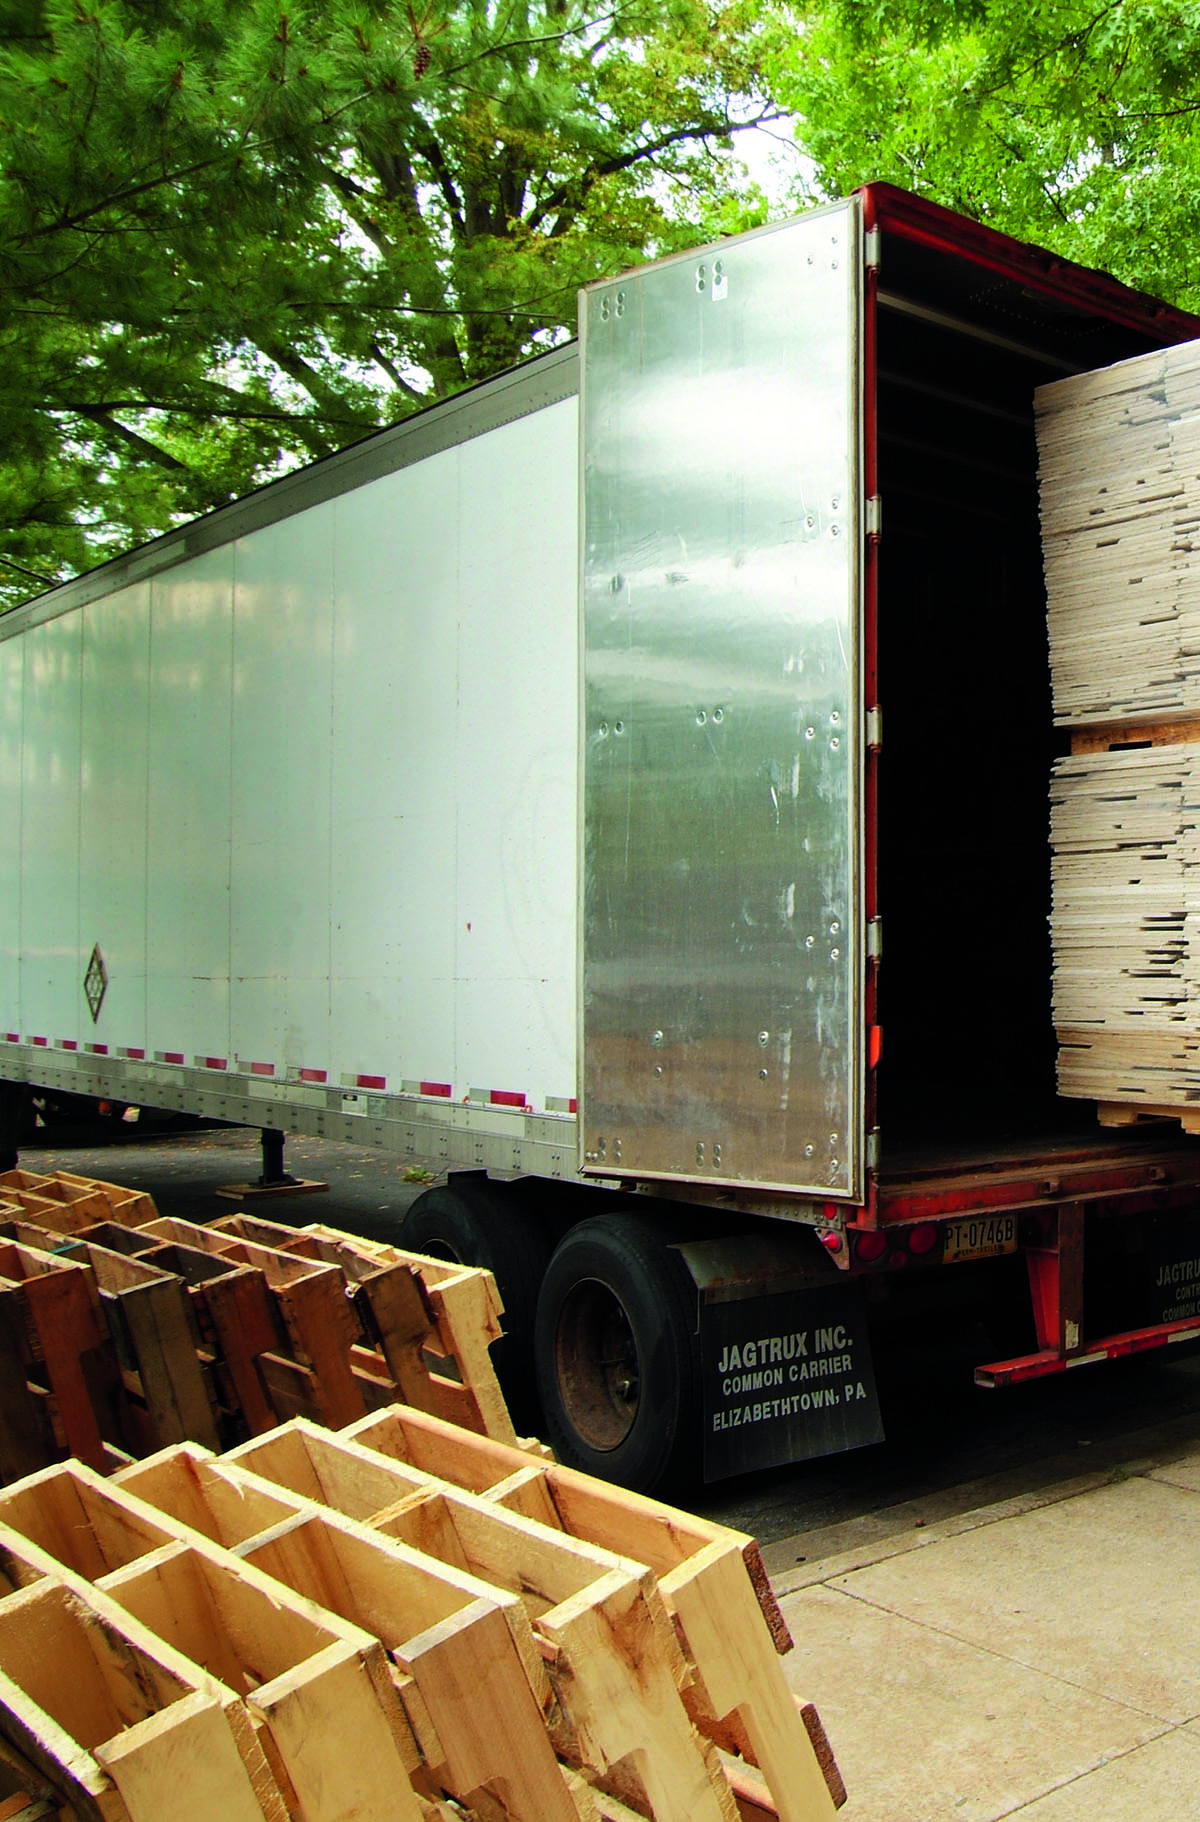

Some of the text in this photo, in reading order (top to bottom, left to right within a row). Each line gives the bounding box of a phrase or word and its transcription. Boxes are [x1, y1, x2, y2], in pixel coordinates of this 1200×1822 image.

[1162, 1302, 1196, 1321] COMMON
[718, 1325, 853, 1373] JAGTRUX INC.
[722, 1354, 852, 1396] COMMON CARRIER
[713, 1382, 867, 1432] ELIZABETHTOWN, PA
